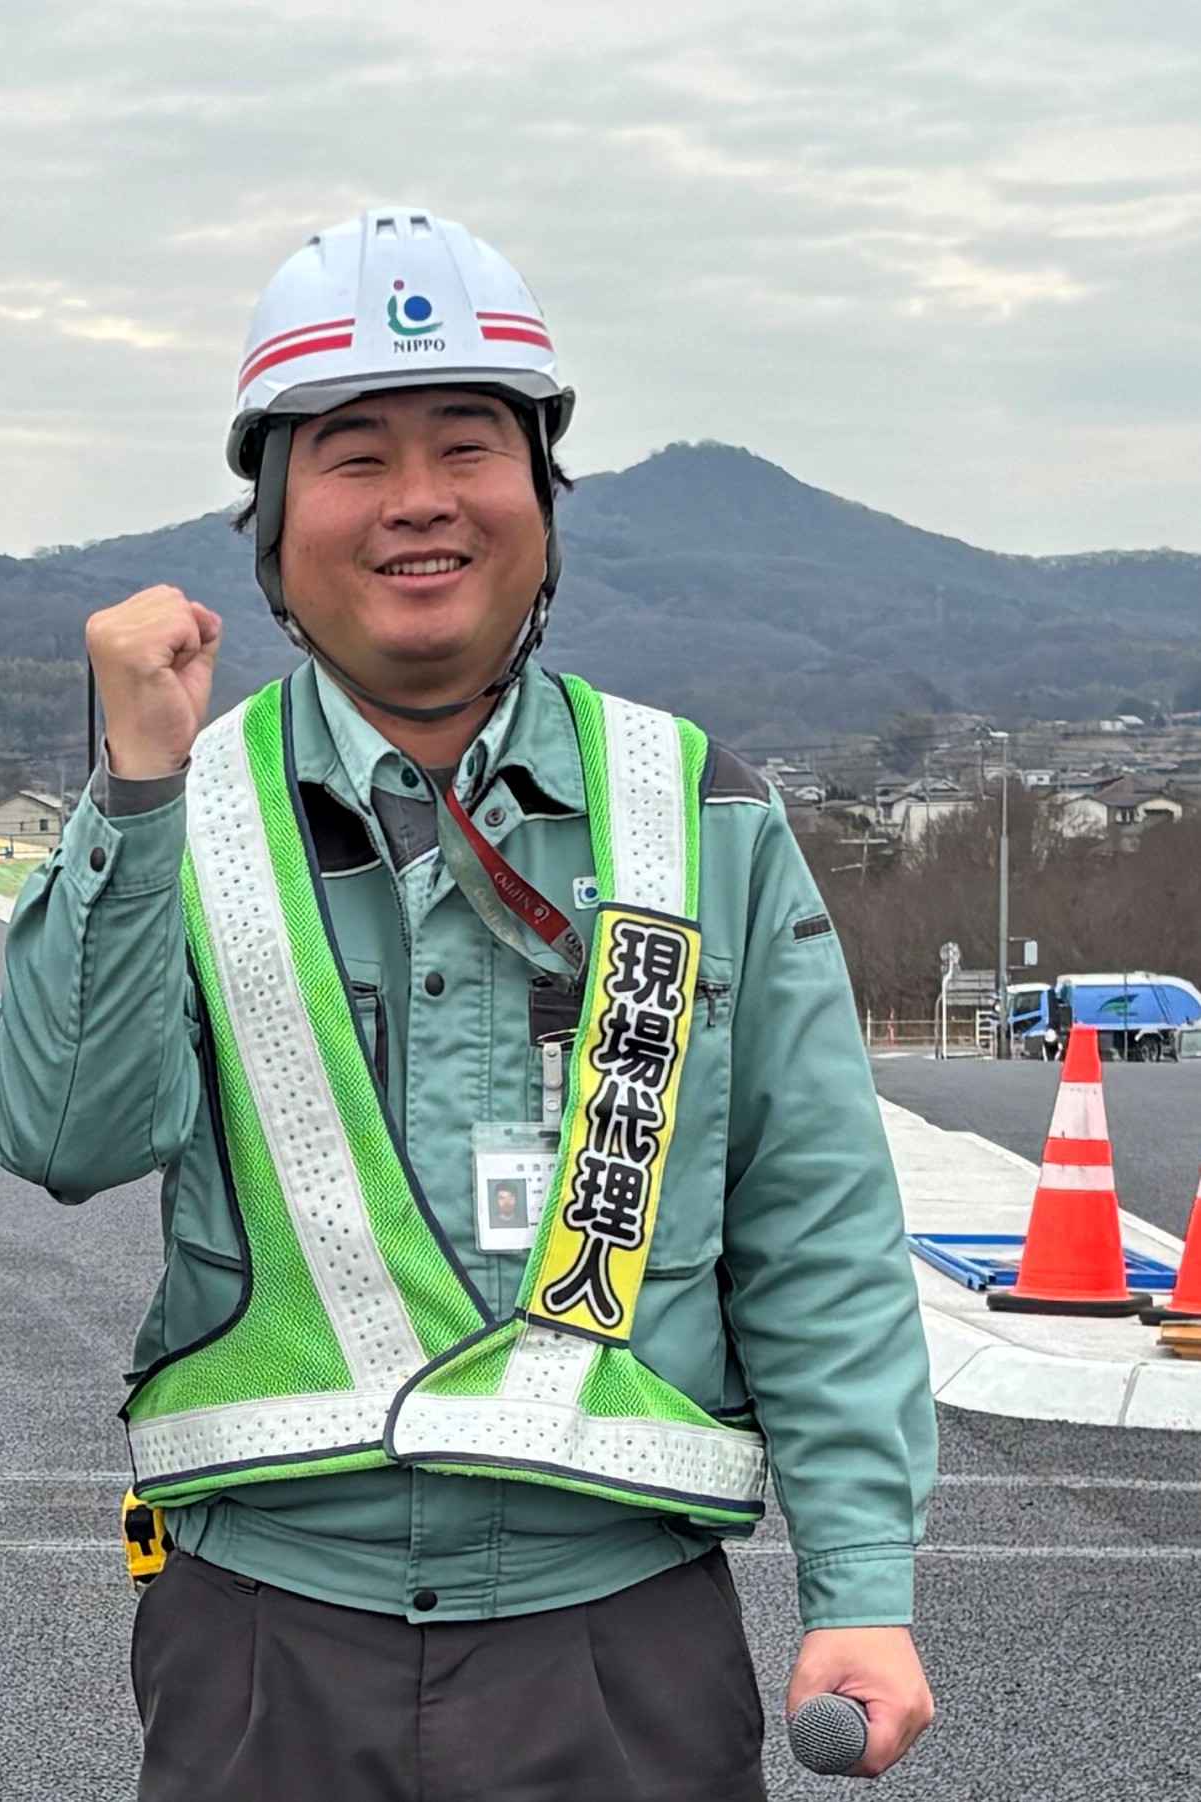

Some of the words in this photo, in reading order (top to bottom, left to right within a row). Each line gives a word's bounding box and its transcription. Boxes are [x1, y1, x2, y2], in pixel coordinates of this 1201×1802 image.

[393, 338, 446, 353] NIPPO
[494, 871, 535, 911] NIPPO
[545, 922, 686, 1325] 現場代理人
